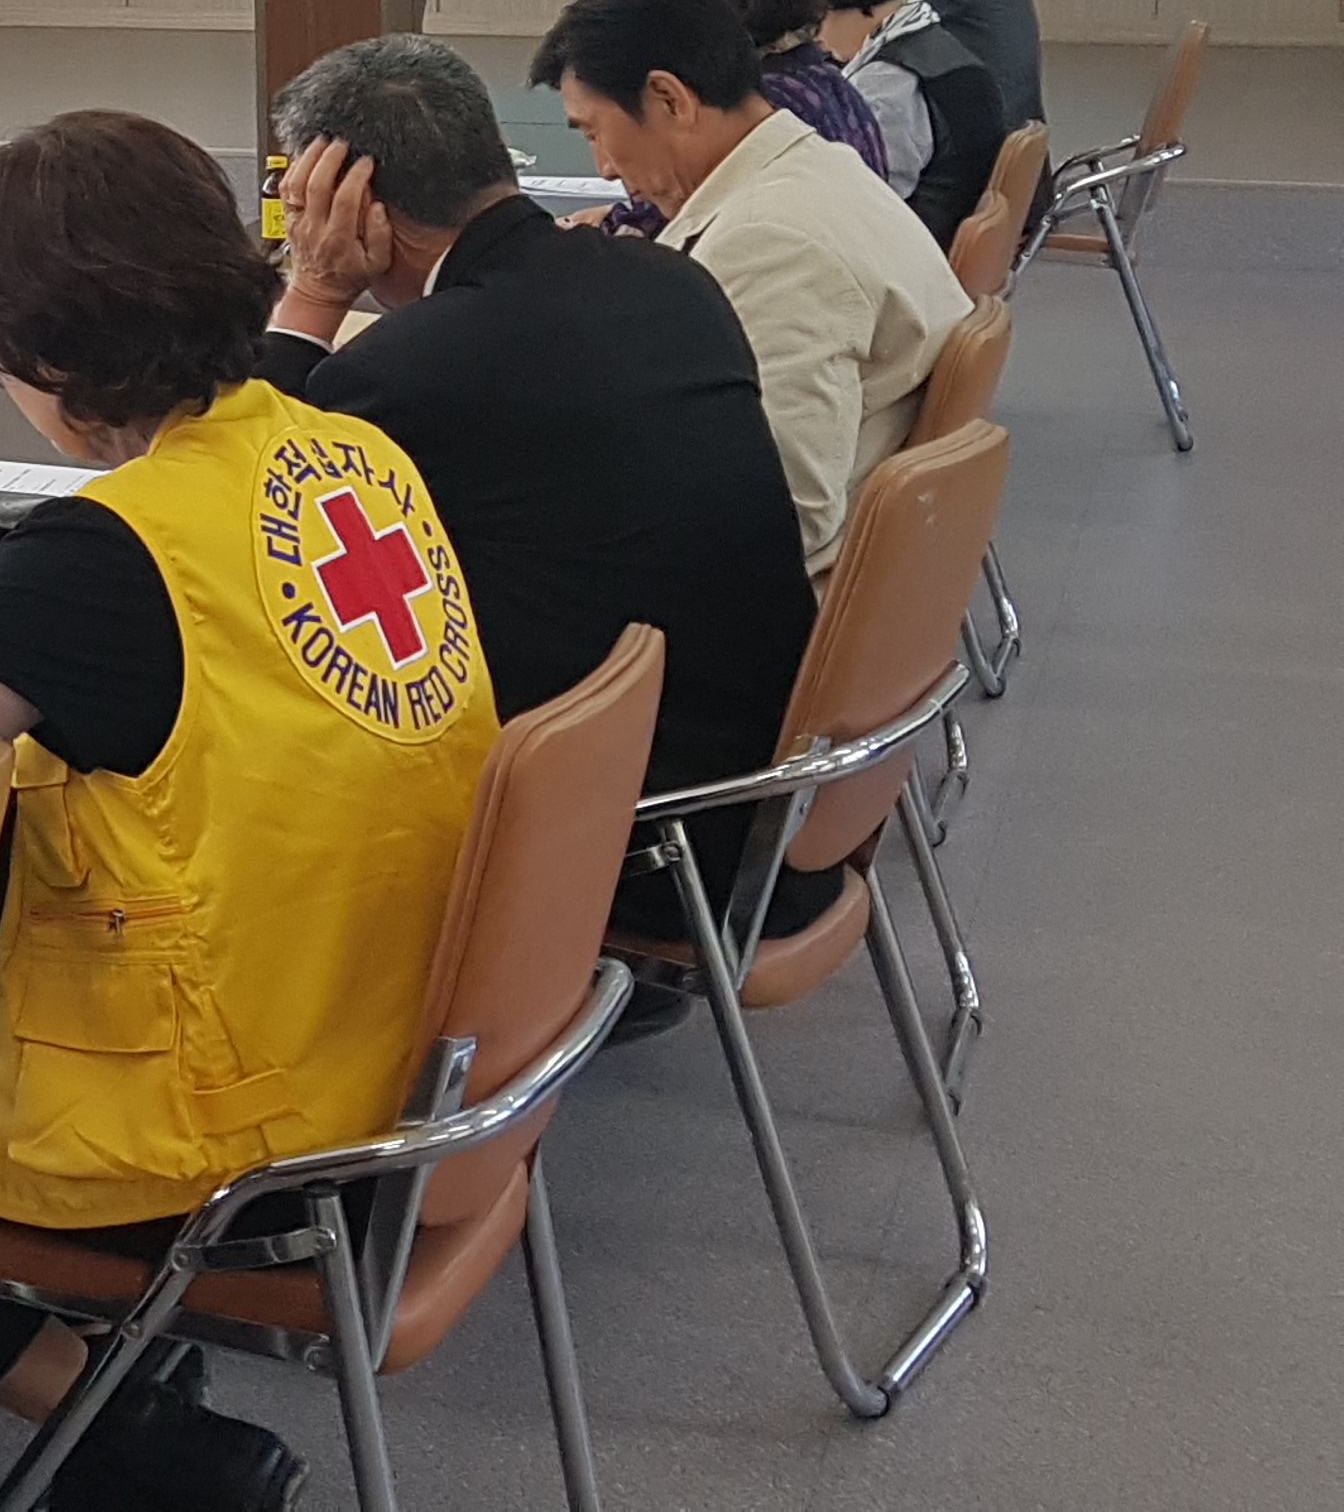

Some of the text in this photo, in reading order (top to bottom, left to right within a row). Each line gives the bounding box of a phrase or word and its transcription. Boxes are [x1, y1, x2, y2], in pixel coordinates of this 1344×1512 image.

[260, 437, 416, 566] 대한적십자사
[281, 544, 471, 731] KOREAN RED CROSS
